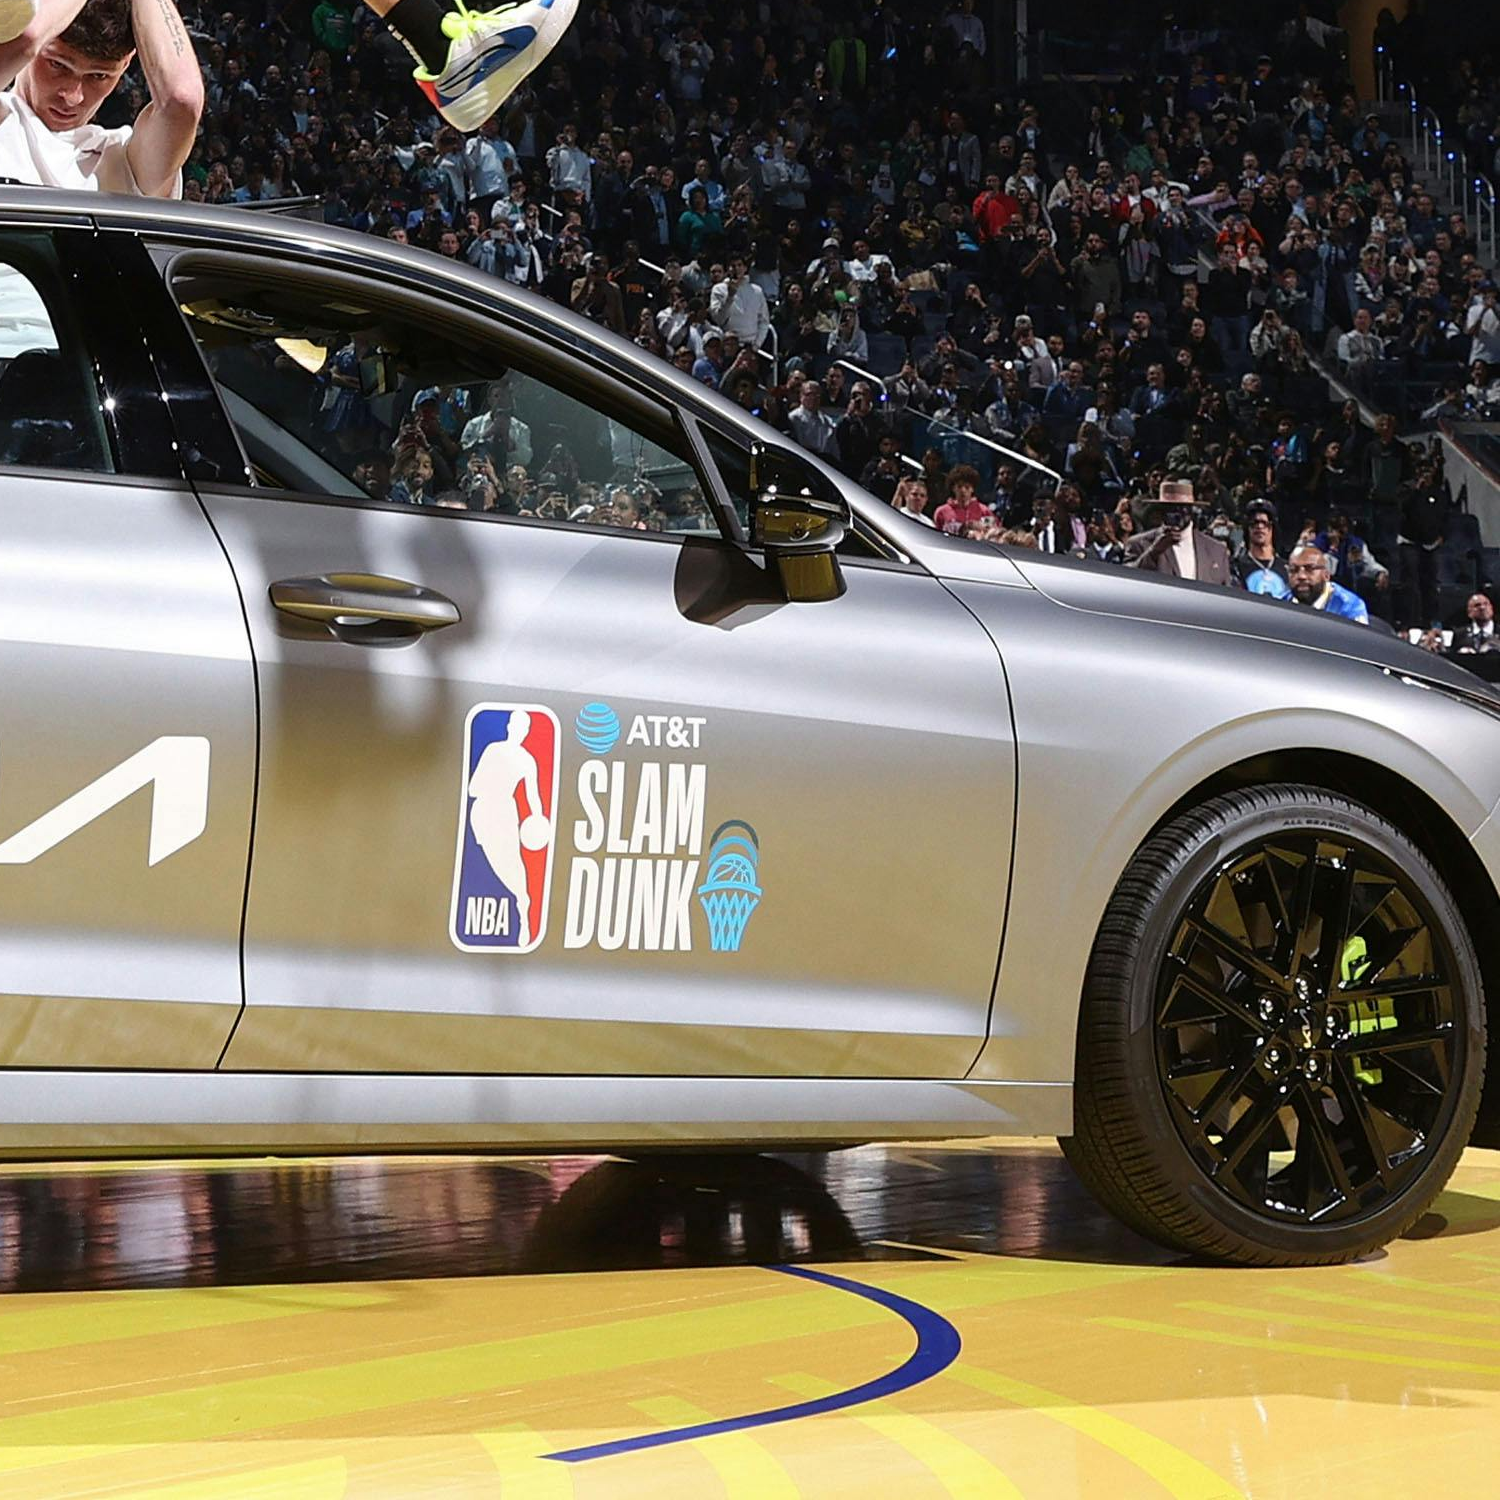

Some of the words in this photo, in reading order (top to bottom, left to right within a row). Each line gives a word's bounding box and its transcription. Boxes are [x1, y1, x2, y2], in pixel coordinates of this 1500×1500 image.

[626, 715, 707, 749] AT&T
[573, 760, 707, 856] SLAM
[465, 897, 510, 937] NBA
[564, 857, 700, 952] DUNK
